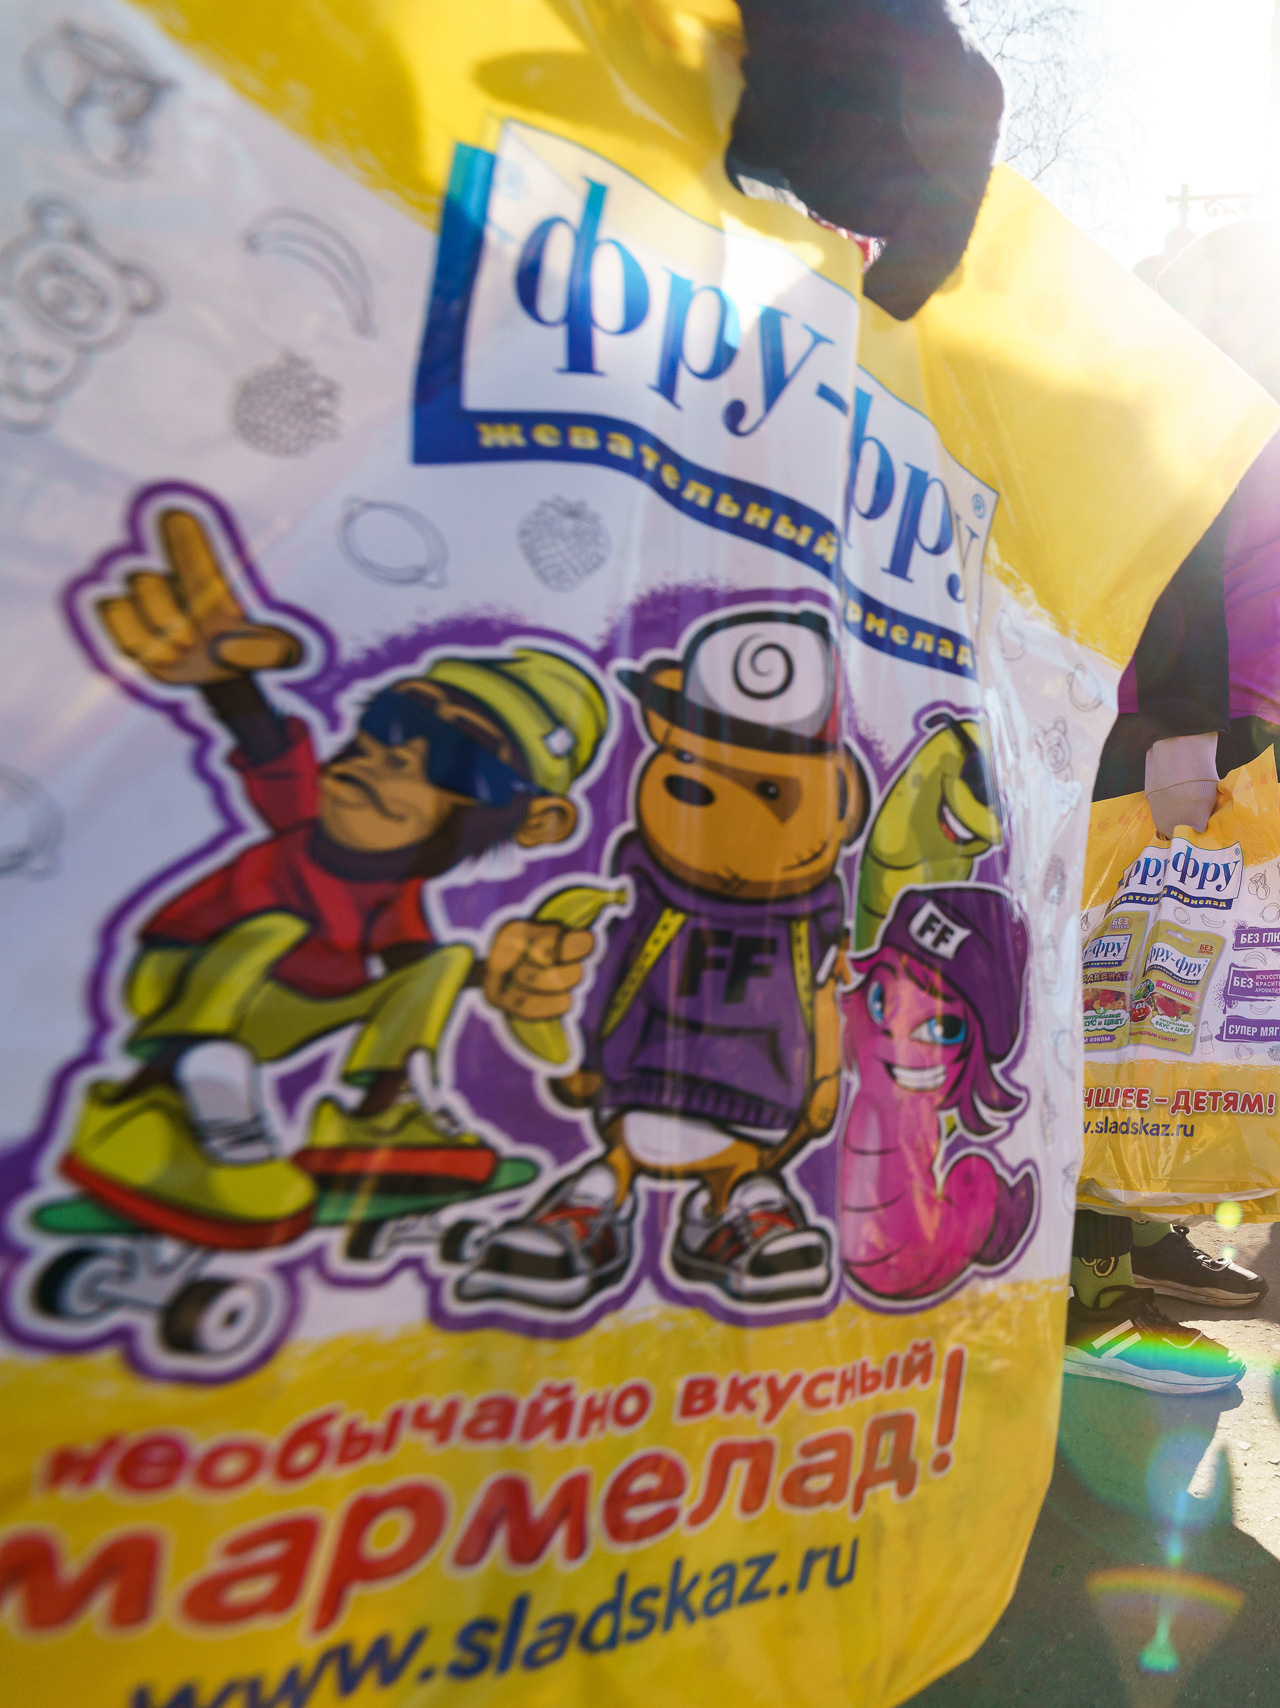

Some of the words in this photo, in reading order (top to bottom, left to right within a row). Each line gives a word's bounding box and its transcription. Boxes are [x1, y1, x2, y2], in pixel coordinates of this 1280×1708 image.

[475, 419, 839, 564] жевательный
[1172, 845, 1241, 892] фру
[1170, 889, 1227, 908] мармелад
[915, 911, 957, 950] FF
[1112, 918, 1129, 926] БЕЗ
[1199, 943, 1214, 952] БЕЗ
[1240, 933, 1260, 944] БЕЗ
[677, 926, 779, 1005] FF
[1233, 976, 1254, 989] БЕЗ
[1228, 1024, 1258, 1037] СУПЕР
[1083, 1087, 1150, 1110] ЧШЕЕ
[1170, 1089, 1276, 1115] ДЕТЯМ!
[40, 1380, 655, 1497] необычайно
[678, 1340, 935, 1421] вкусный
[0, 1346, 967, 1634] мармелад!
